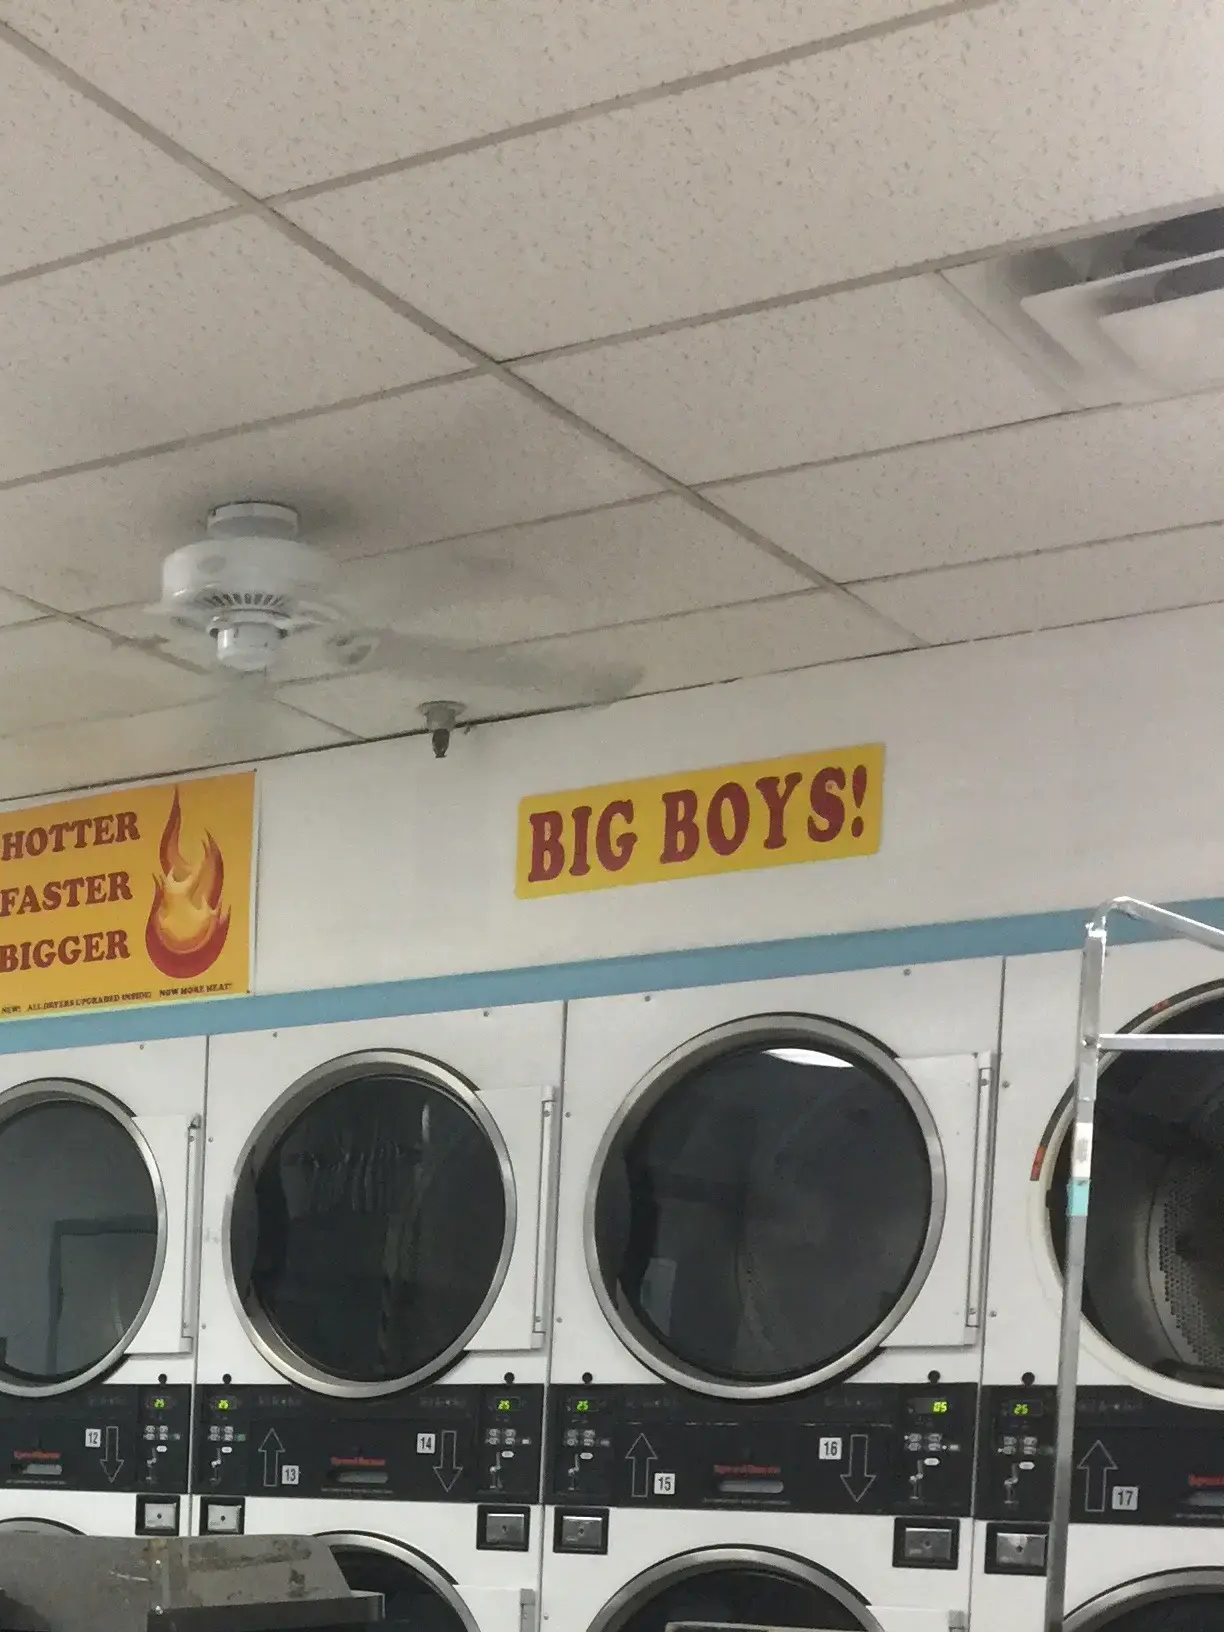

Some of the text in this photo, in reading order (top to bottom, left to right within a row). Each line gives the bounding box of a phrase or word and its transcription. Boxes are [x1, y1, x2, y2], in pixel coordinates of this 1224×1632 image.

[0, 811, 141, 861] HOTTER
[528, 765, 868, 883] BIG BOYS!
[0, 871, 133, 918] FASTER
[27, 1003, 42, 1012] ALL
[43, 999, 74, 1010] DRYERS
[75, 994, 120, 1007] UPGRADED
[159, 988, 178, 998] NOW
[180, 985, 204, 995] MORE
[576, 1400, 589, 1411] 25
[933, 1401, 948, 1412] 05
